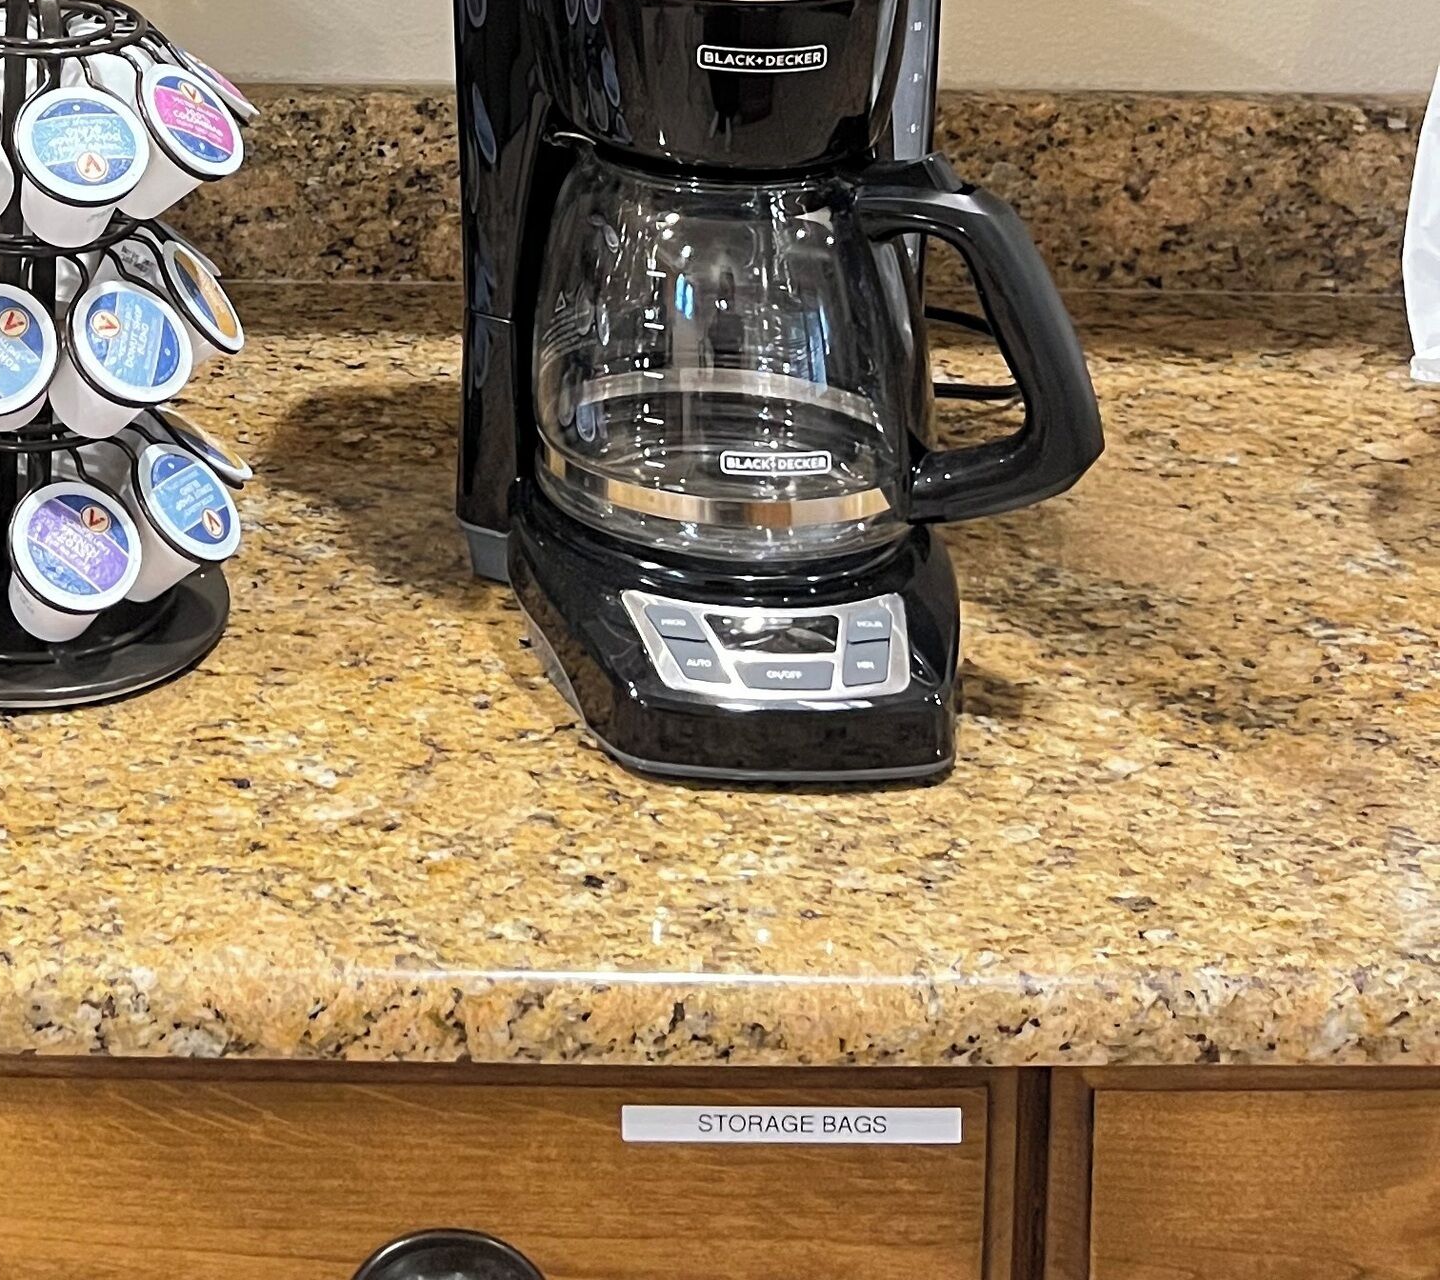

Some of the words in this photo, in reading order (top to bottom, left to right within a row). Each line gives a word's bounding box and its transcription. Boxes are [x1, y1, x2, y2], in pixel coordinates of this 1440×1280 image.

[122, 332, 140, 368] DONUT
[686, 657, 712, 668] AUTO
[698, 1113, 814, 1133] STORAGE
[823, 1114, 887, 1134] BAGS
